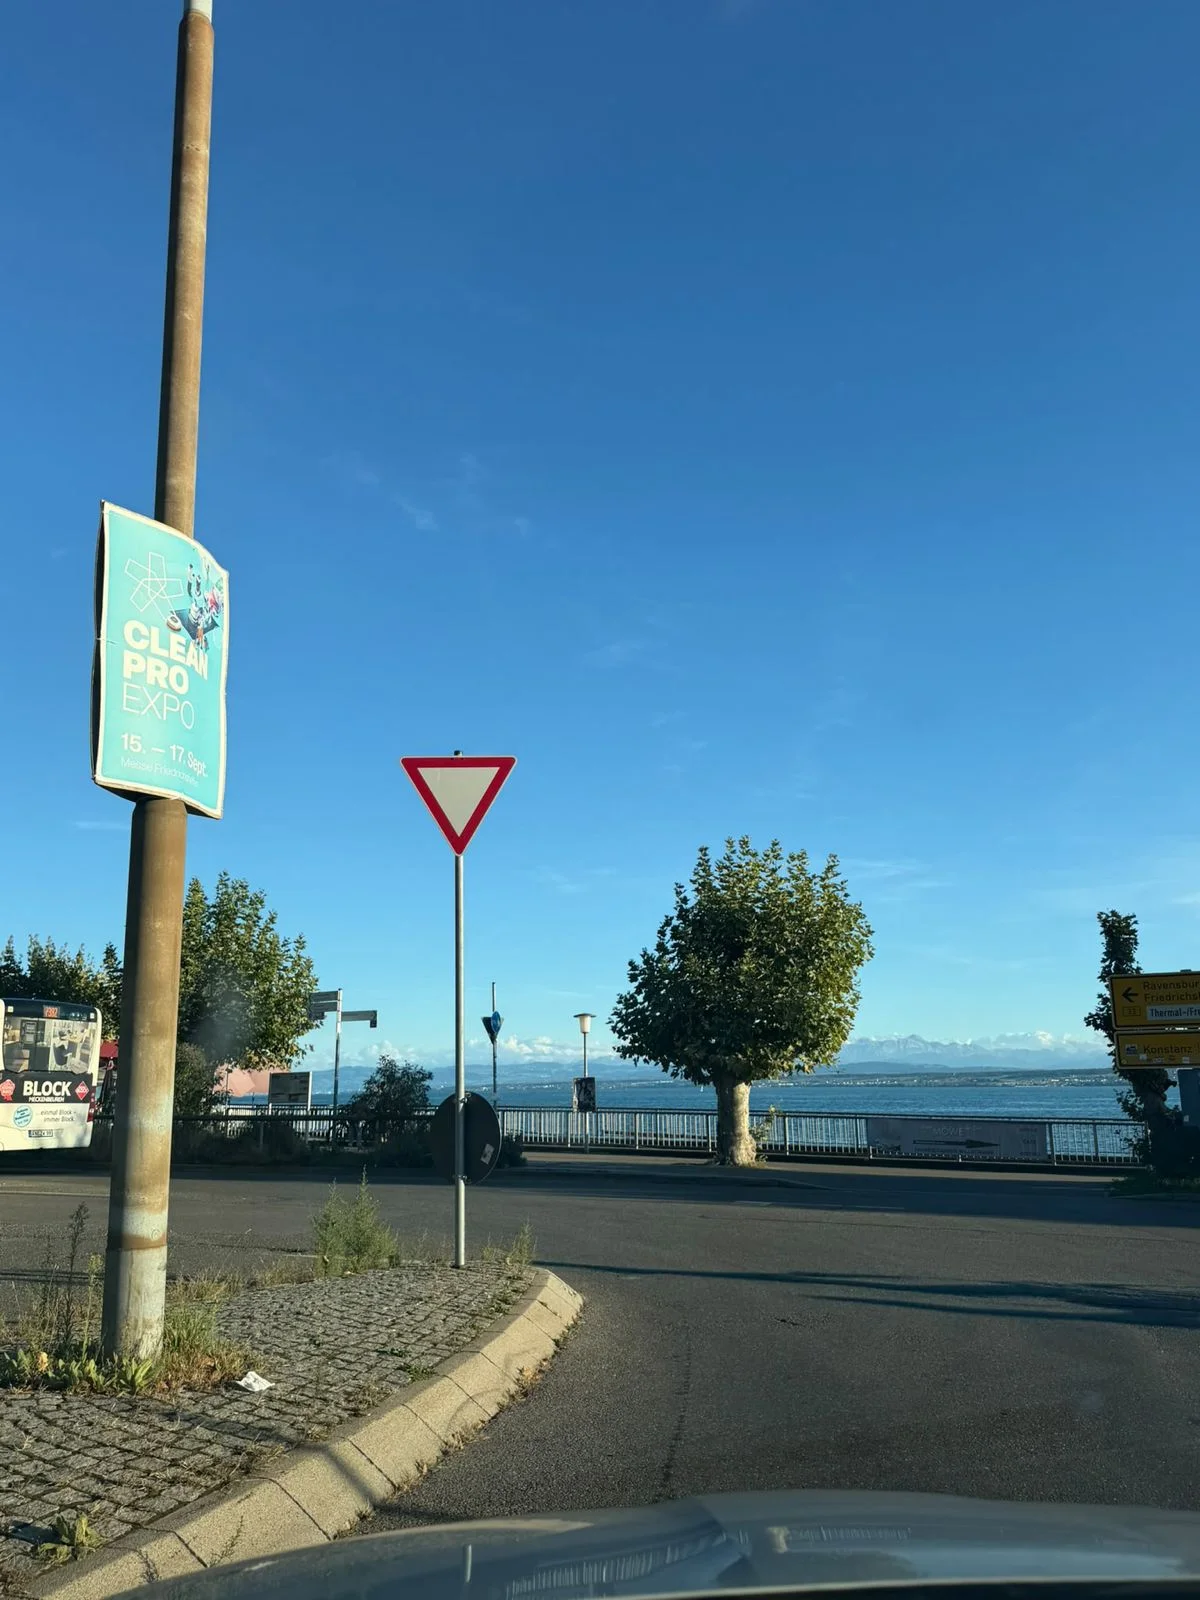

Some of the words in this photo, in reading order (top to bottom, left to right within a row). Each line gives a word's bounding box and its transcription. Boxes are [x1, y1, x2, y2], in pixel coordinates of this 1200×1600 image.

[123, 619, 208, 680] CLEAN
[123, 650, 189, 694] PRO
[123, 682, 195, 730] EXPO
[121, 733, 146, 755] 15.
[1144, 991, 1200, 1002] Friedrichs
[1143, 1044, 1193, 1054] Konstanz
[23, 1080, 72, 1097] BLOCK
